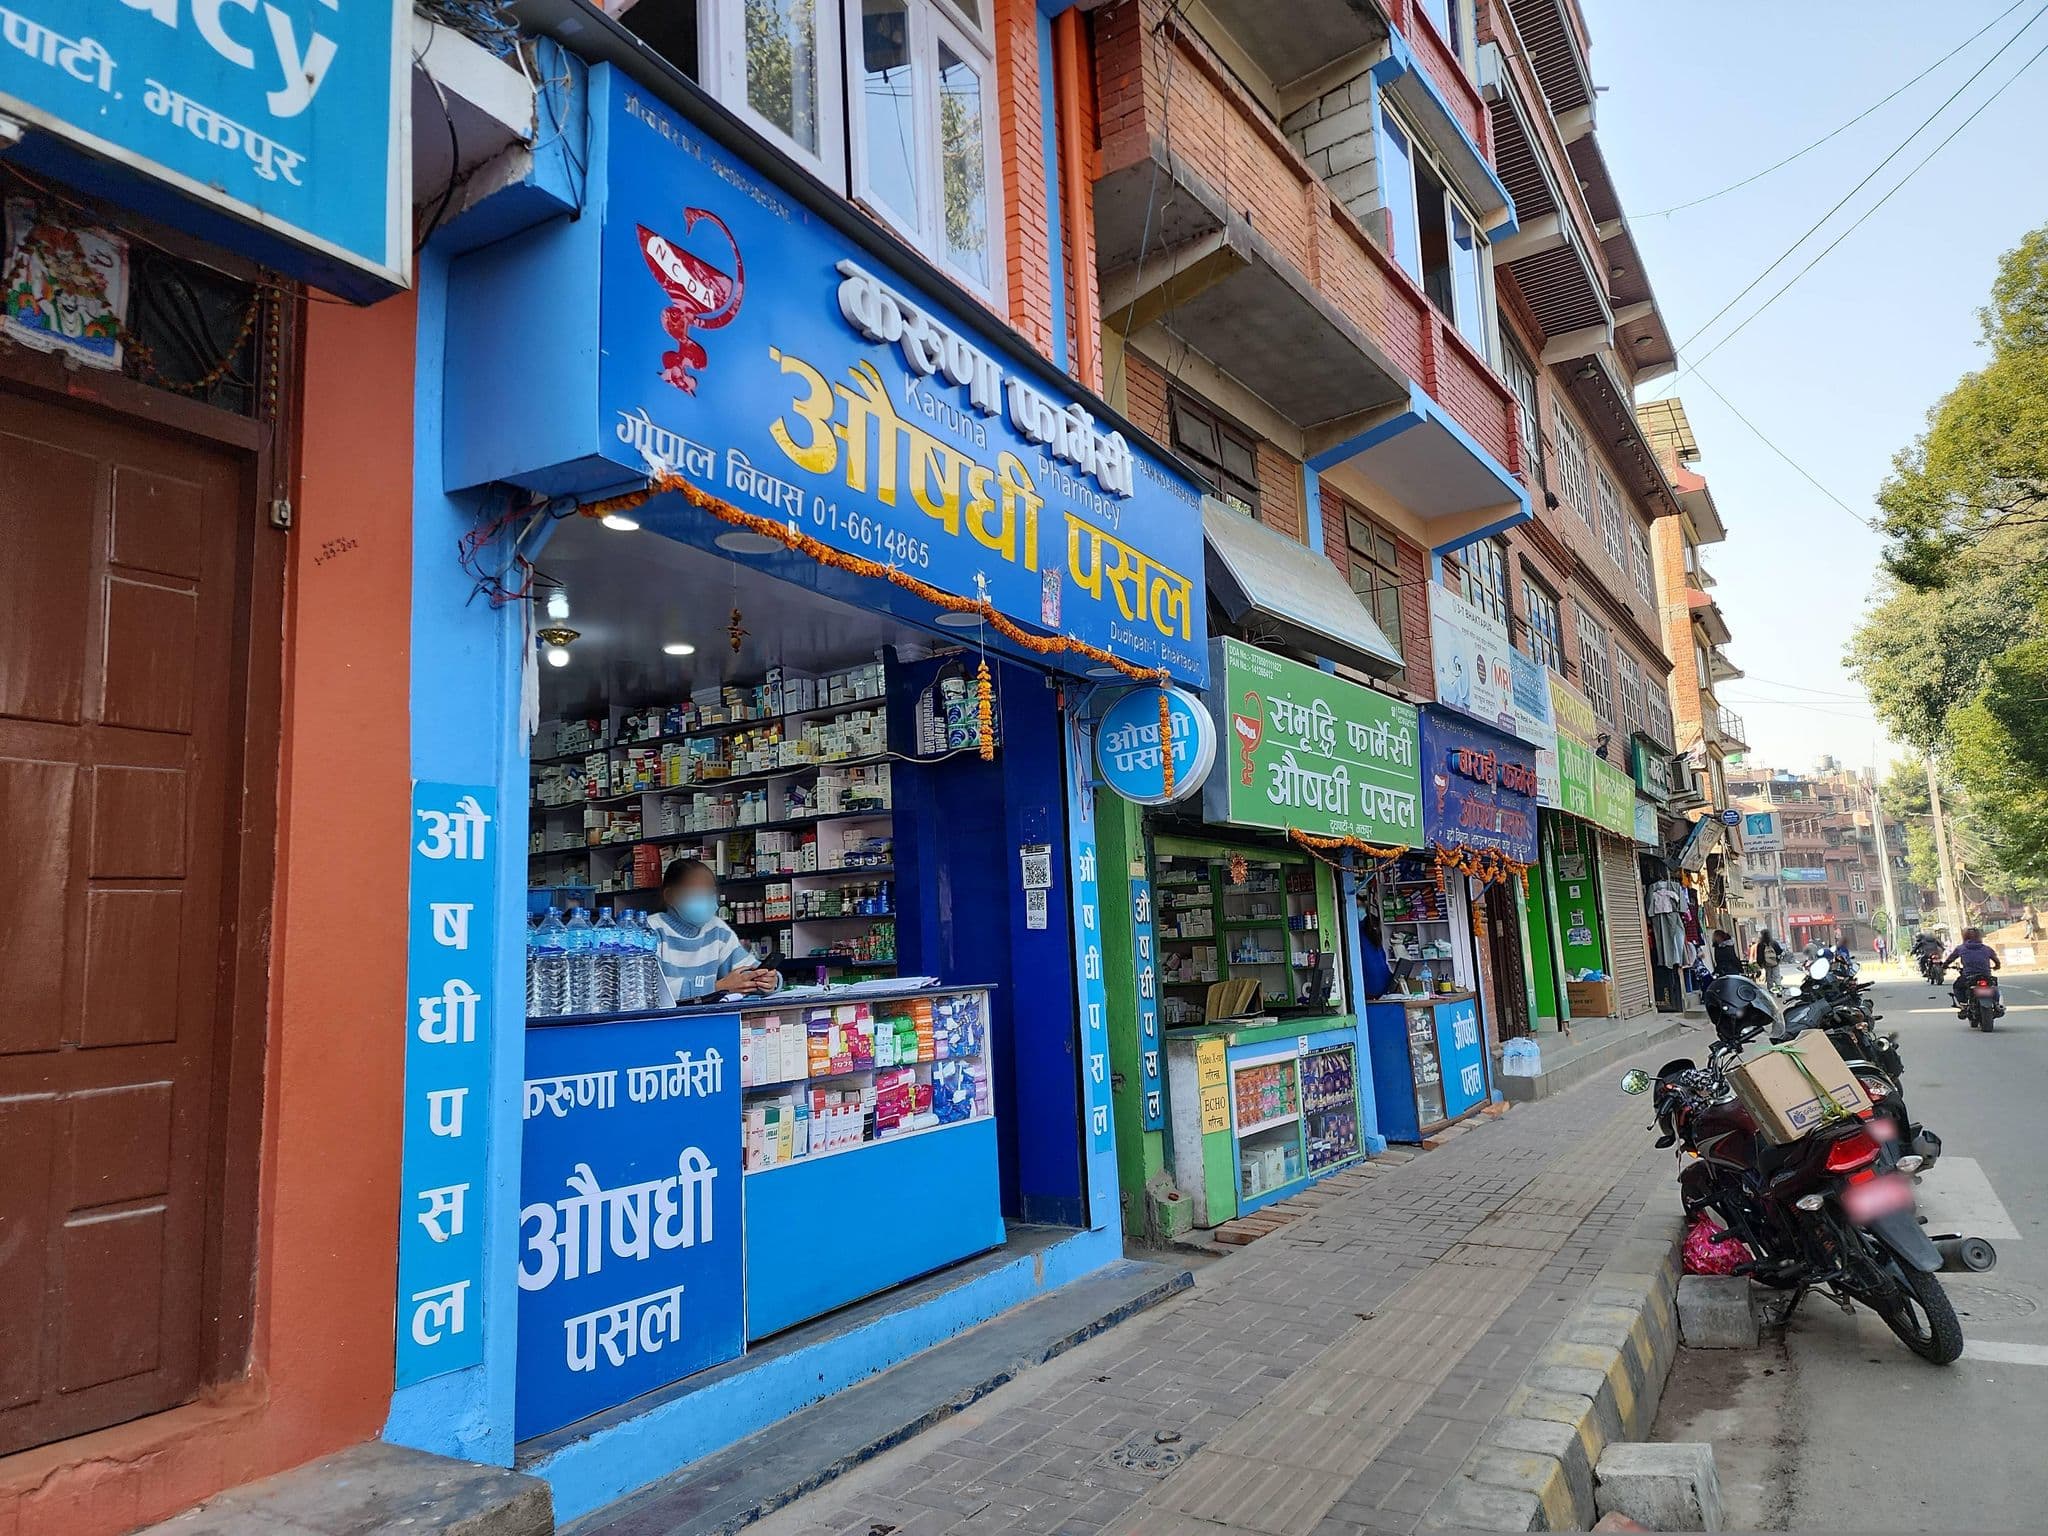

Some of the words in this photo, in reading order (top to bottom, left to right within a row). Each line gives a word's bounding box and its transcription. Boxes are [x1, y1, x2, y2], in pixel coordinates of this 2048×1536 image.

[143, 77, 307, 187] भक्तपुर
[654, 243, 714, 308] NCDA
[616, 407, 717, 481] गोपाल
[725, 447, 806, 518] निवास
[904, 373, 988, 450] Karuna
[1037, 454, 1122, 531] Pharmacy
[1004, 375, 1135, 499] फार्मेसी
[769, 345, 1045, 573] औषधी
[1063, 511, 1193, 642] पसल
[812, 495, 930, 570] 01-6614865
[1493, 663, 1513, 694] MRI
[1346, 719, 1413, 768] फार्मेसी
[1266, 750, 1351, 816] औषधी
[1360, 782, 1416, 828] पसल
[626, 1047, 724, 1105] फार्मेसी
[1204, 1096, 1226, 1112] ECHO
[517, 1146, 718, 1291] औषधी
[563, 1284, 685, 1373] पसल
